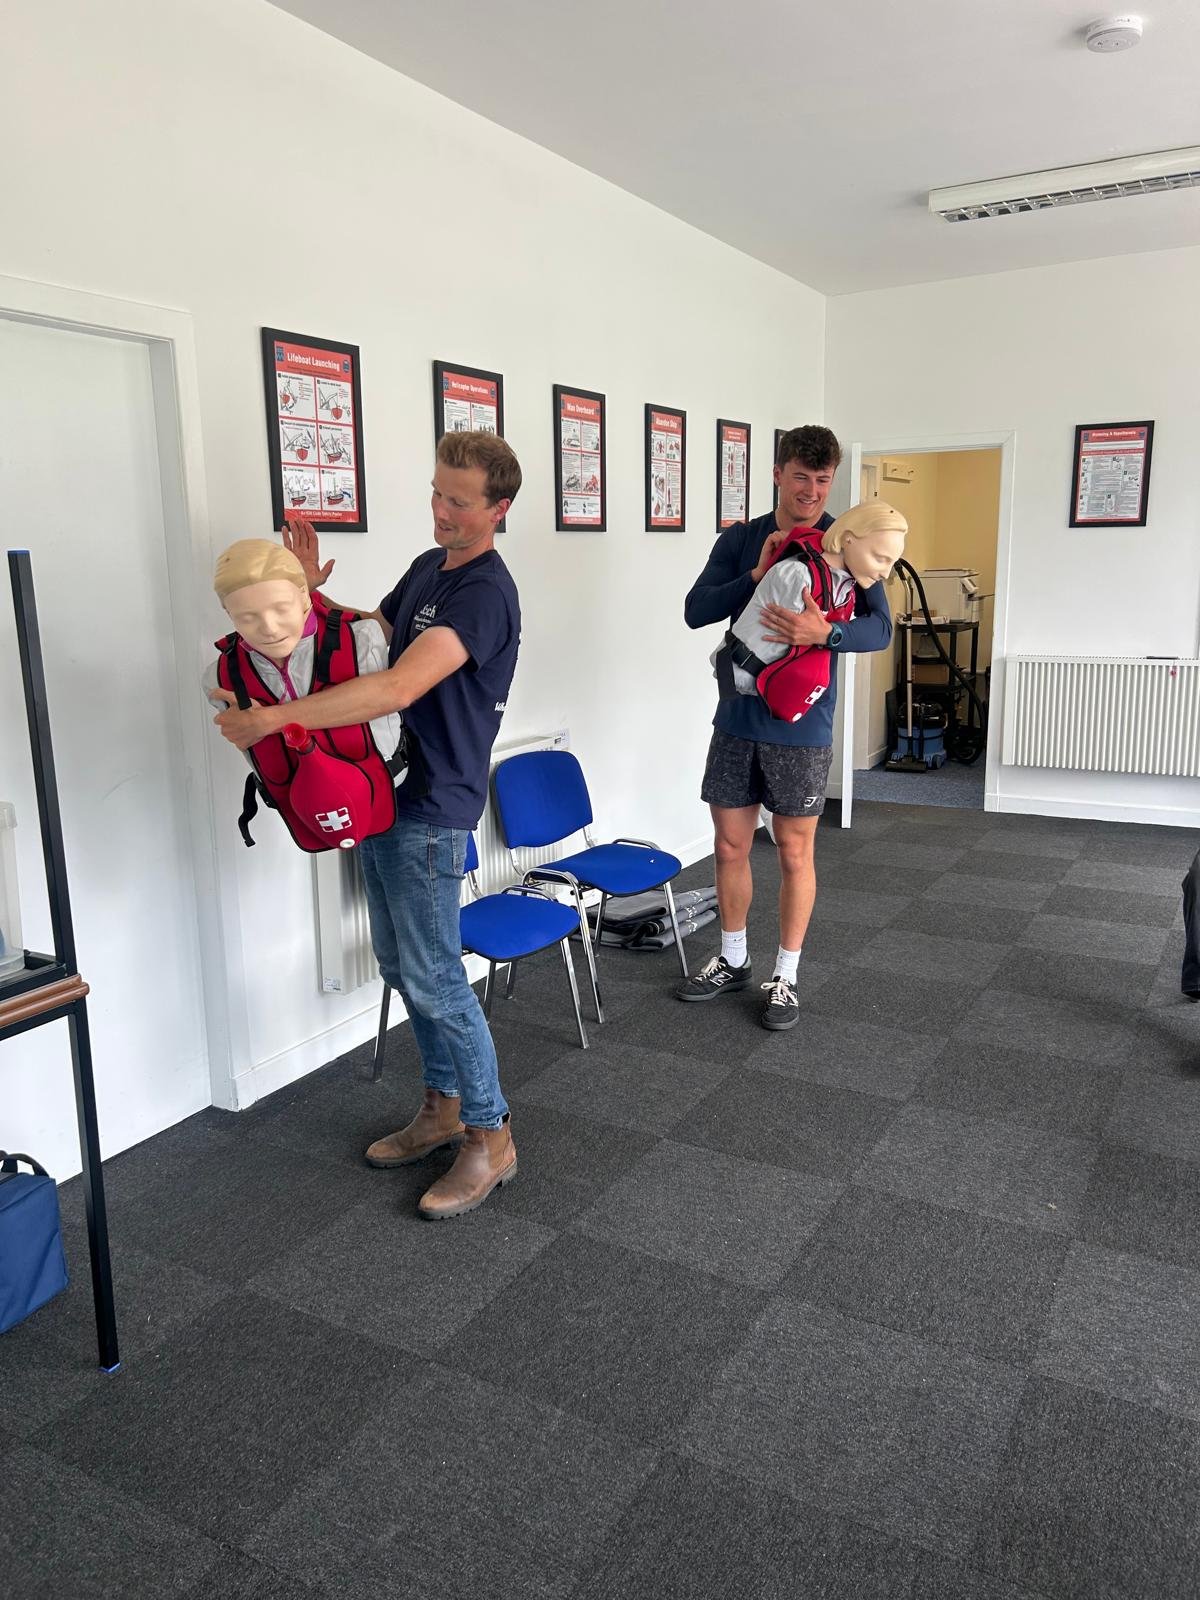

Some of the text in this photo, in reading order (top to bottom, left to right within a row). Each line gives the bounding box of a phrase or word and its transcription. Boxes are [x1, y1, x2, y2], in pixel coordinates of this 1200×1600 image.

[287, 353, 311, 366] Lifeboat
[312, 357, 340, 372] Launching
[451, 381, 470, 391] Helicopter
[470, 385, 489, 395] Operations
[566, 403, 595, 415] Man Overboard
